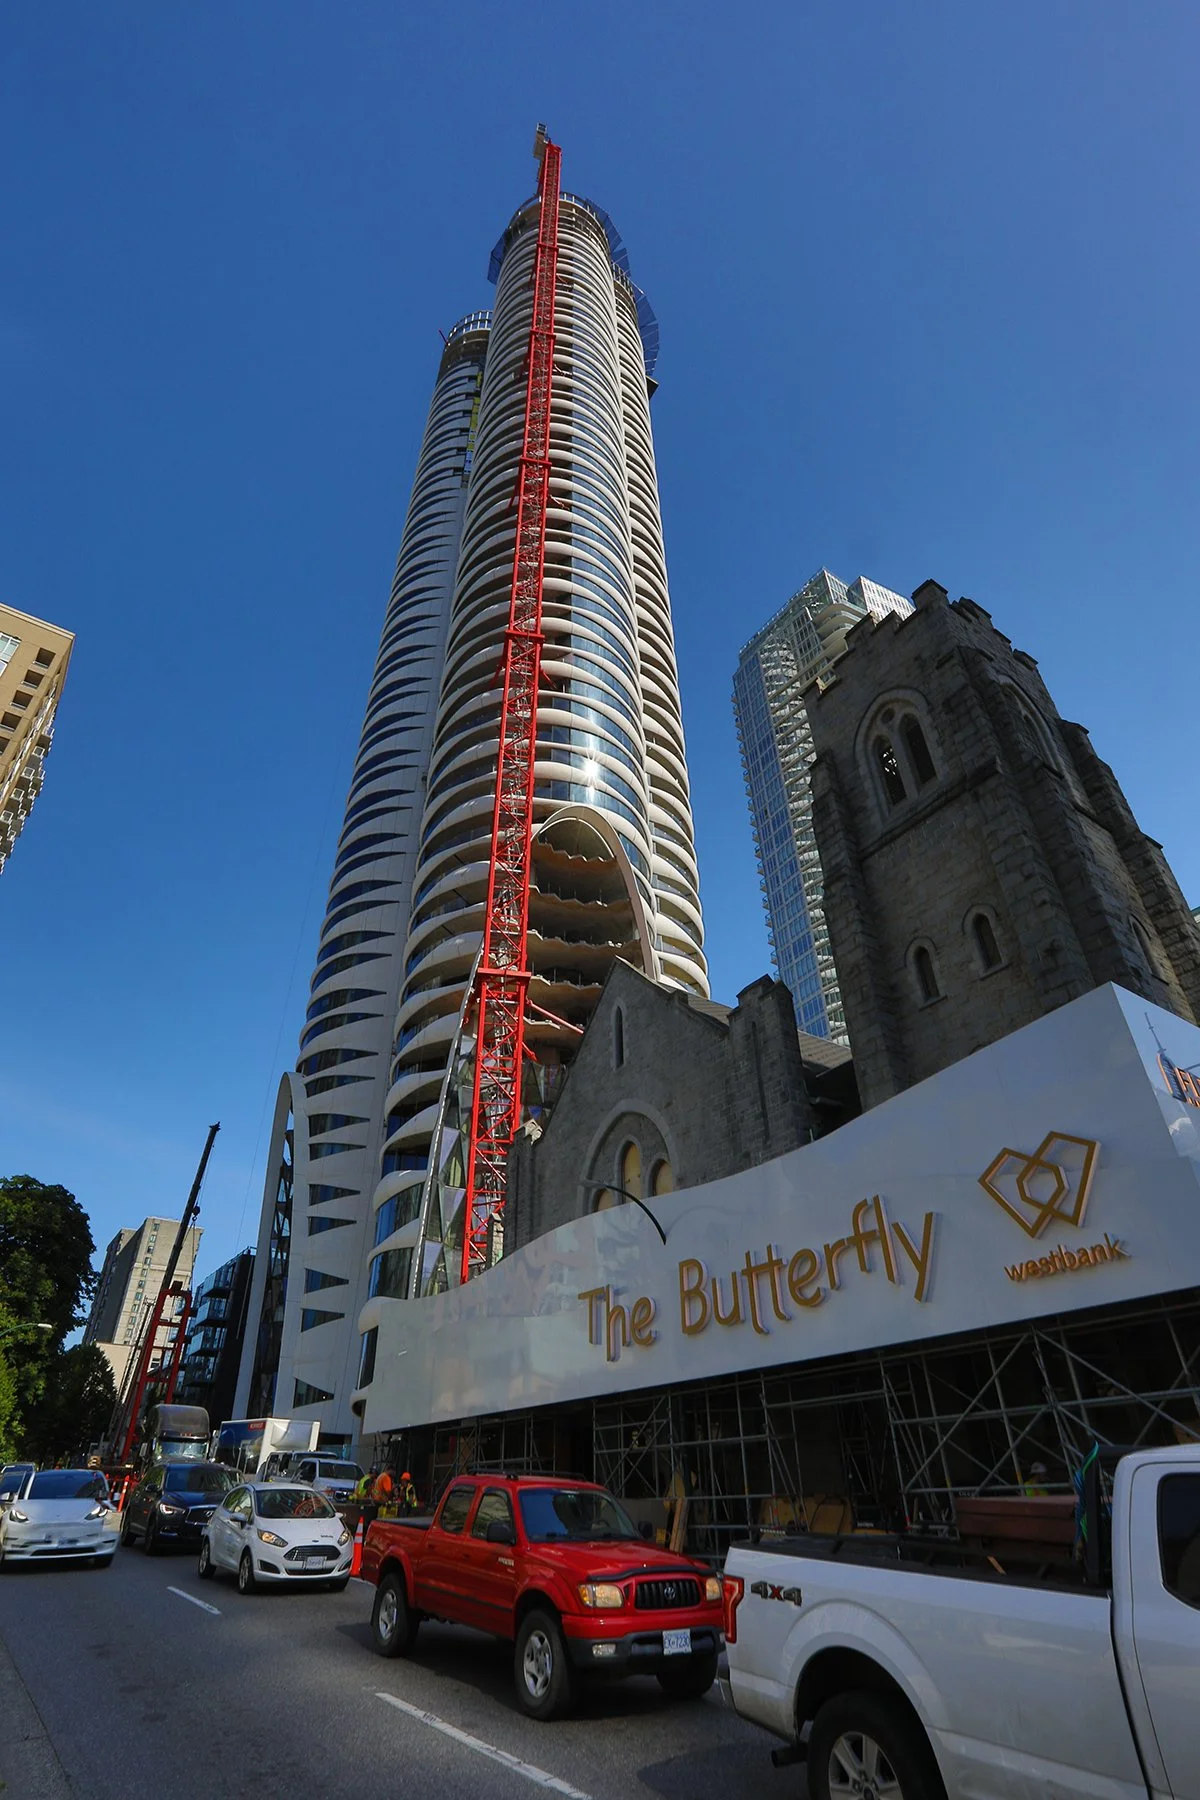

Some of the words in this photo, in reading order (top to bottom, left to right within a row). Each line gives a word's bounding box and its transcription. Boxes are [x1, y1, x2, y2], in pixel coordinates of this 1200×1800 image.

[577, 1283, 657, 1362] The
[678, 1194, 939, 1336] Butterfly
[1003, 1231, 1132, 1282] westbank
